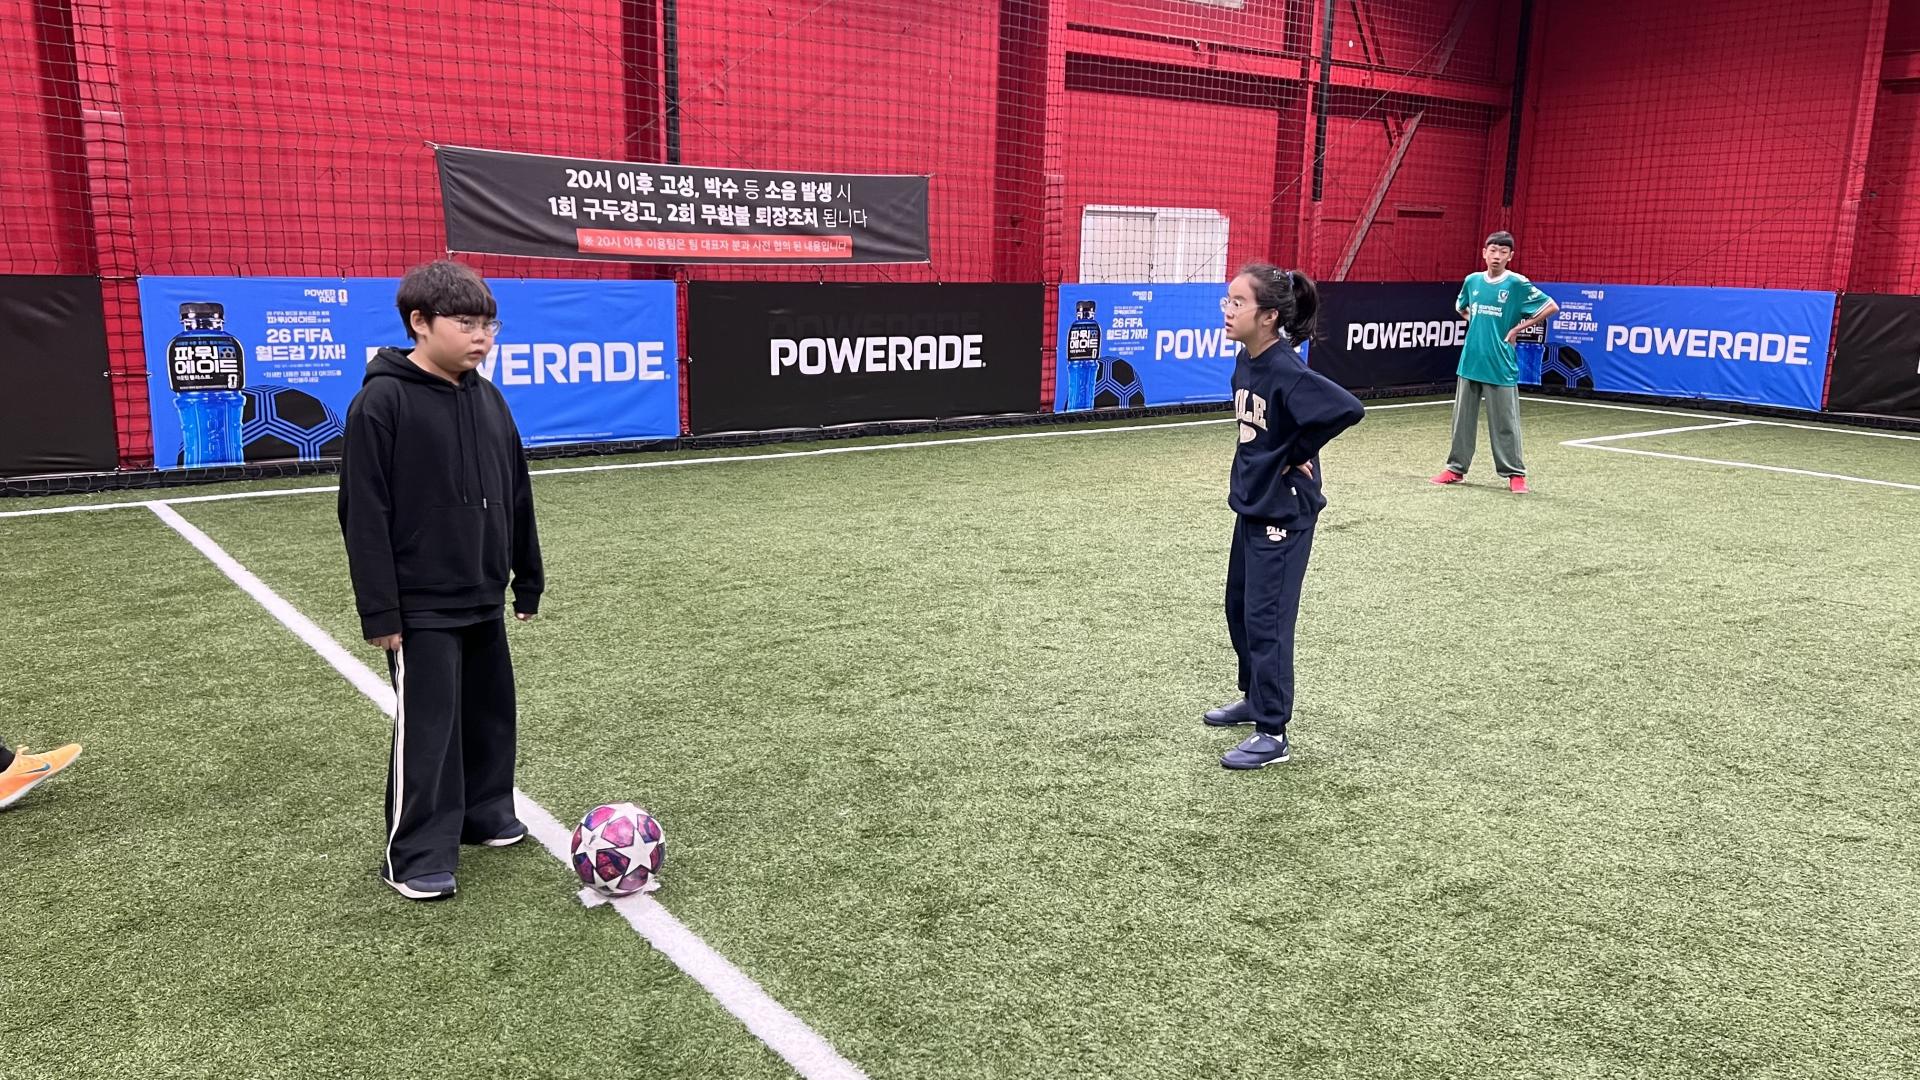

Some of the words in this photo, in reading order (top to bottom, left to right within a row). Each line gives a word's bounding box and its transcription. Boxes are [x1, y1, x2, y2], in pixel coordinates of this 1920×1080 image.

[565, 169, 612, 193] 20시
[617, 172, 655, 195] 이후
[659, 175, 700, 198] 고성,
[704, 177, 739, 199] 박수
[743, 179, 760, 200] 등
[765, 180, 797, 201] 소음
[801, 181, 832, 202] 발생
[836, 183, 851, 202] 시
[548, 196, 577, 219] 1회
[582, 198, 662, 224] 구두경고,
[666, 203, 695, 224] 2회
[701, 203, 750, 226] 무환불
[755, 205, 819, 228] 퇴장조치
[822, 208, 868, 228] 됩니다
[597, 236, 621, 248] 20시
[624, 237, 644, 248] 이후
[647, 237, 685, 250] 이용팀은
[701, 240, 729, 251] 대표자
[753, 240, 771, 251] 사전
[304, 289, 336, 297] POWER
[1112, 318, 1124, 328] 26
[1125, 318, 1143, 328] FIFA
[1559, 311, 1571, 320] 26
[1572, 312, 1592, 321] FIFA
[266, 328, 291, 343] 26
[293, 328, 333, 343] FIFA
[1347, 320, 1467, 351] POWERADE
[256, 345, 305, 361] 월드컵
[307, 344, 346, 360] 가자!
[1606, 325, 1811, 365] POWERADE
[174, 346, 219, 360] 파워
[174, 360, 238, 374] 에이드
